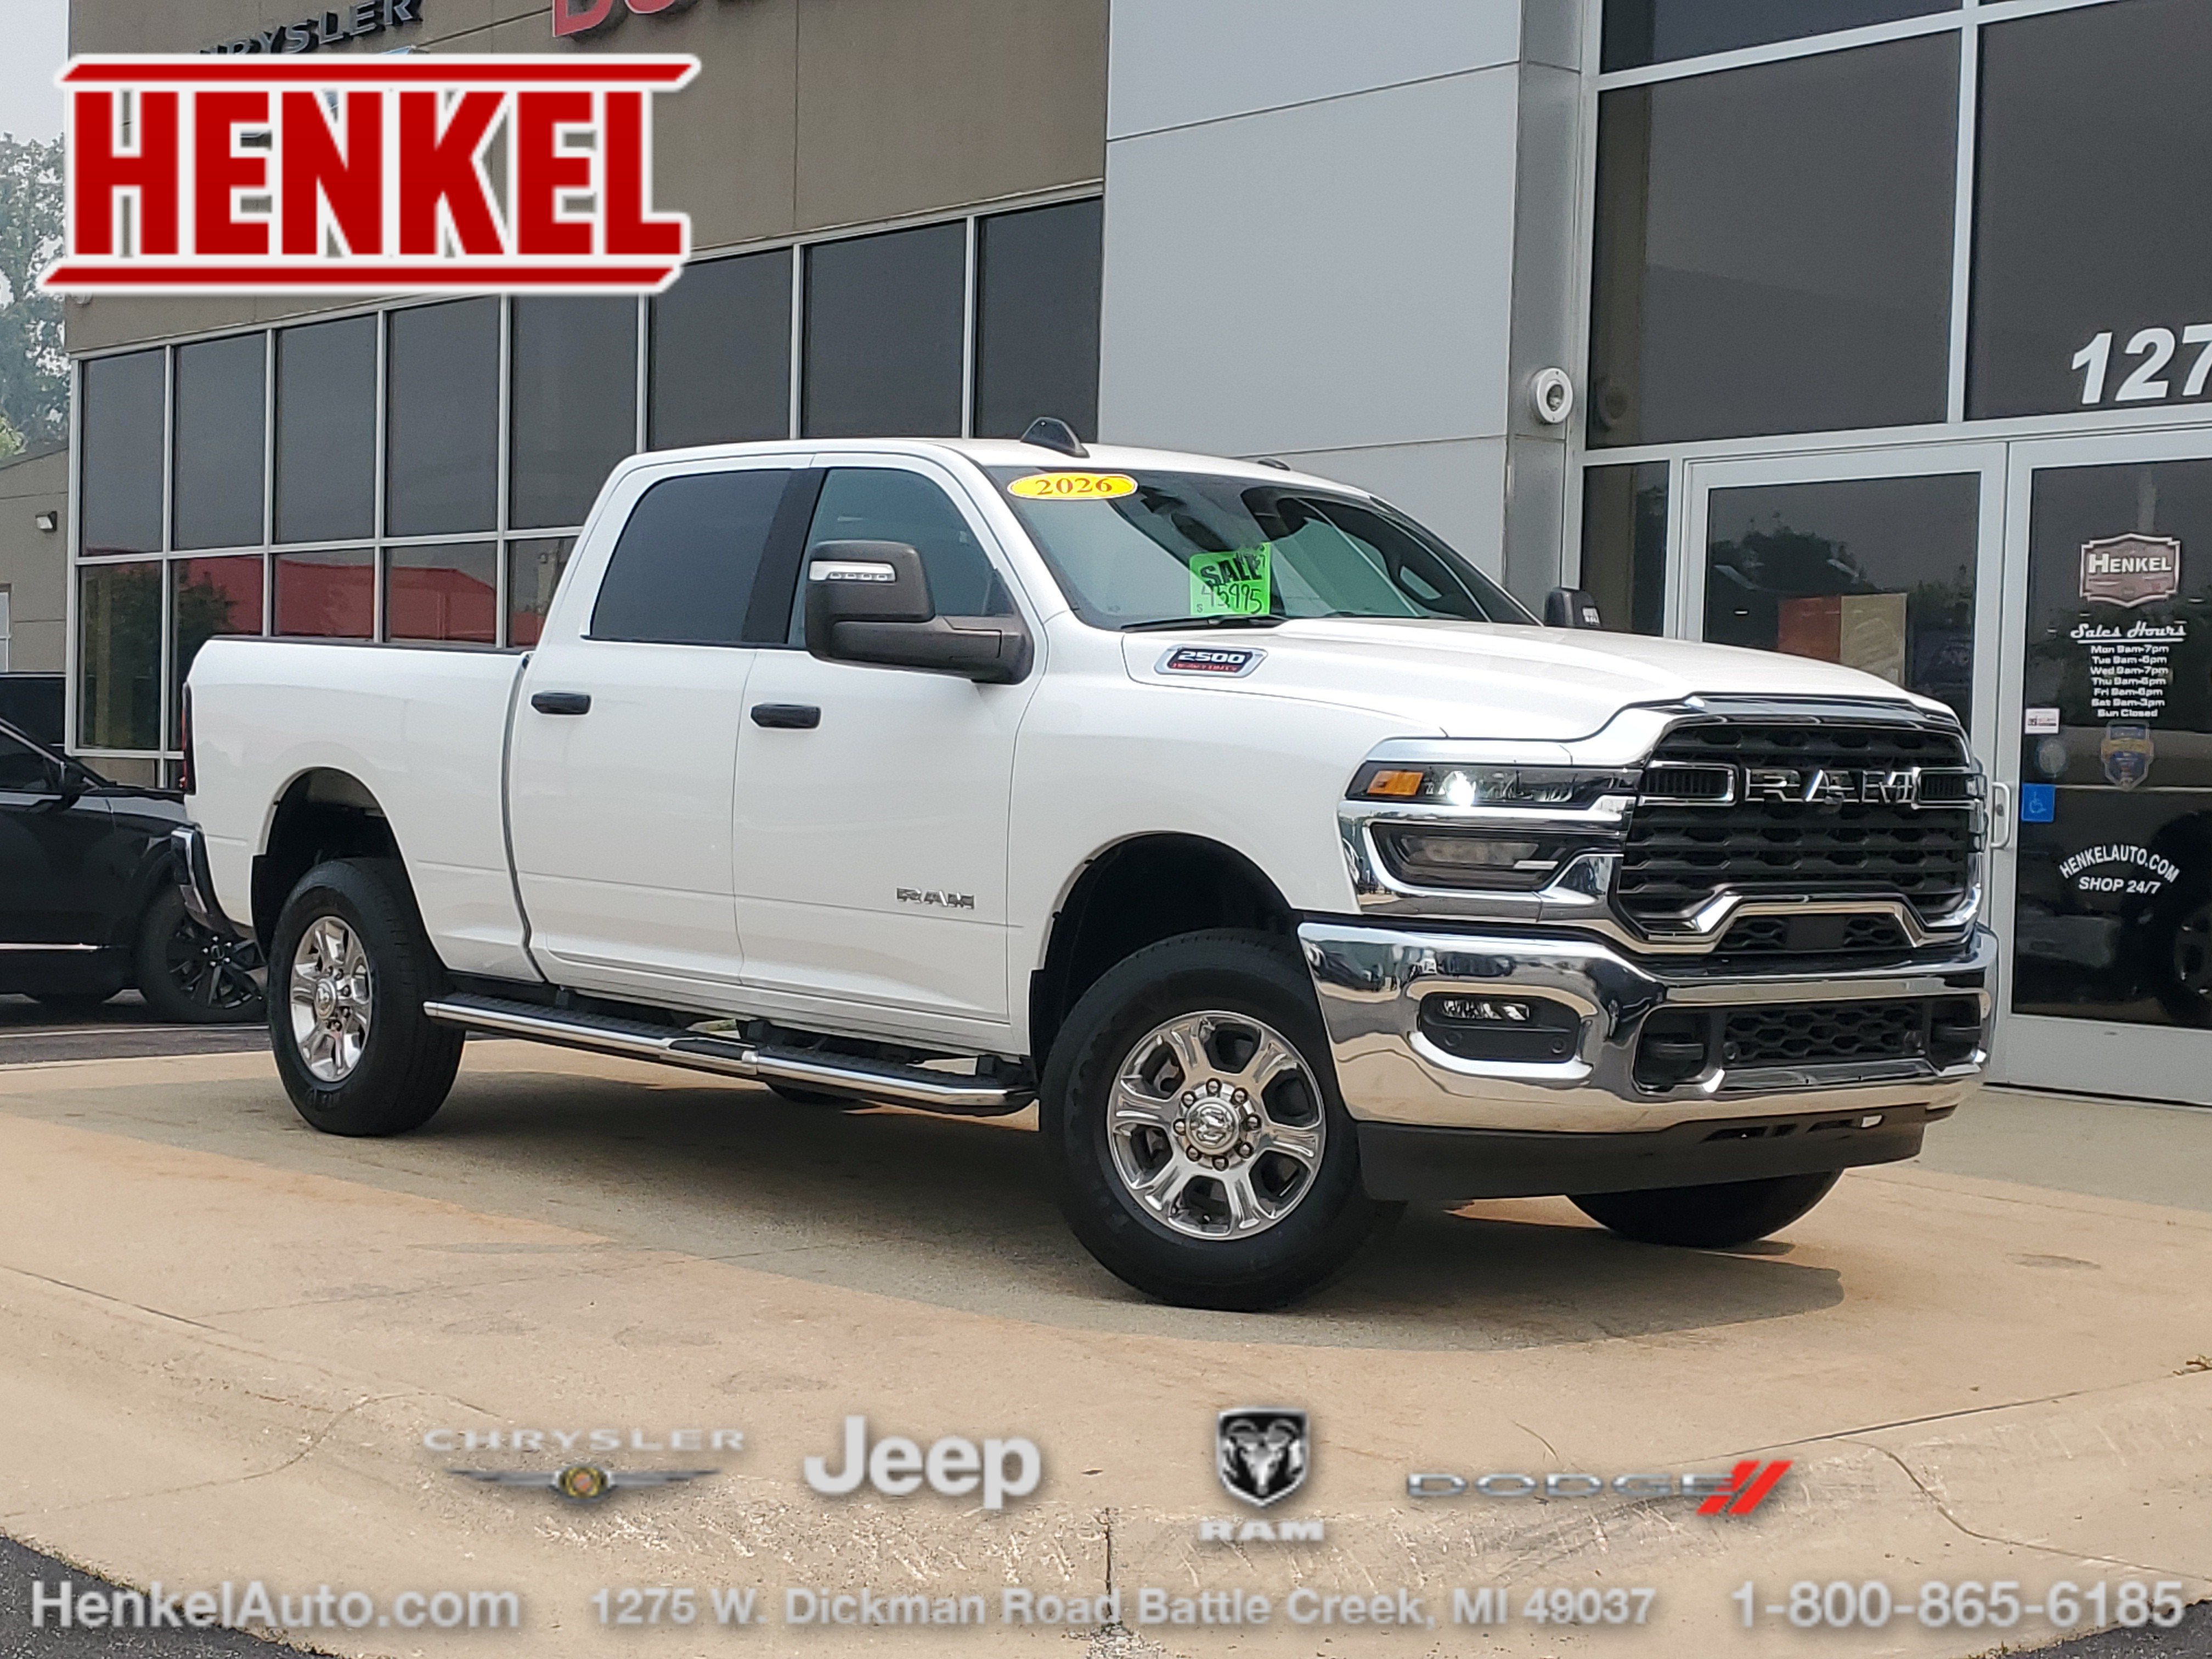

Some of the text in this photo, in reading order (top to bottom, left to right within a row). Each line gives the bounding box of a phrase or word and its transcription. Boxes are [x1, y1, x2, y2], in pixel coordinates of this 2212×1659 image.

[2071, 324, 2212, 404] 127
[1035, 478, 1113, 495] 2026
[1200, 552, 1262, 587] SALE
[2088, 553, 2171, 574] HENKEL
[2070, 620, 2186, 638] Sales Hours
[1178, 651, 1245, 663] 2500
[2091, 645, 2114, 653] Mon
[2091, 656, 2111, 664] Tue
[2090, 666, 2114, 675] Wed
[2091, 677, 2112, 685] Thu
[2094, 687, 2109, 696] Fri
[2097, 709, 2158, 717] Sun Closed
[1745, 768, 1916, 803] RAM
[2059, 843, 2180, 883] HENKELAUTO.COM
[2078, 876, 2162, 894] SHOP 24/7
[896, 887, 974, 910] RAM
